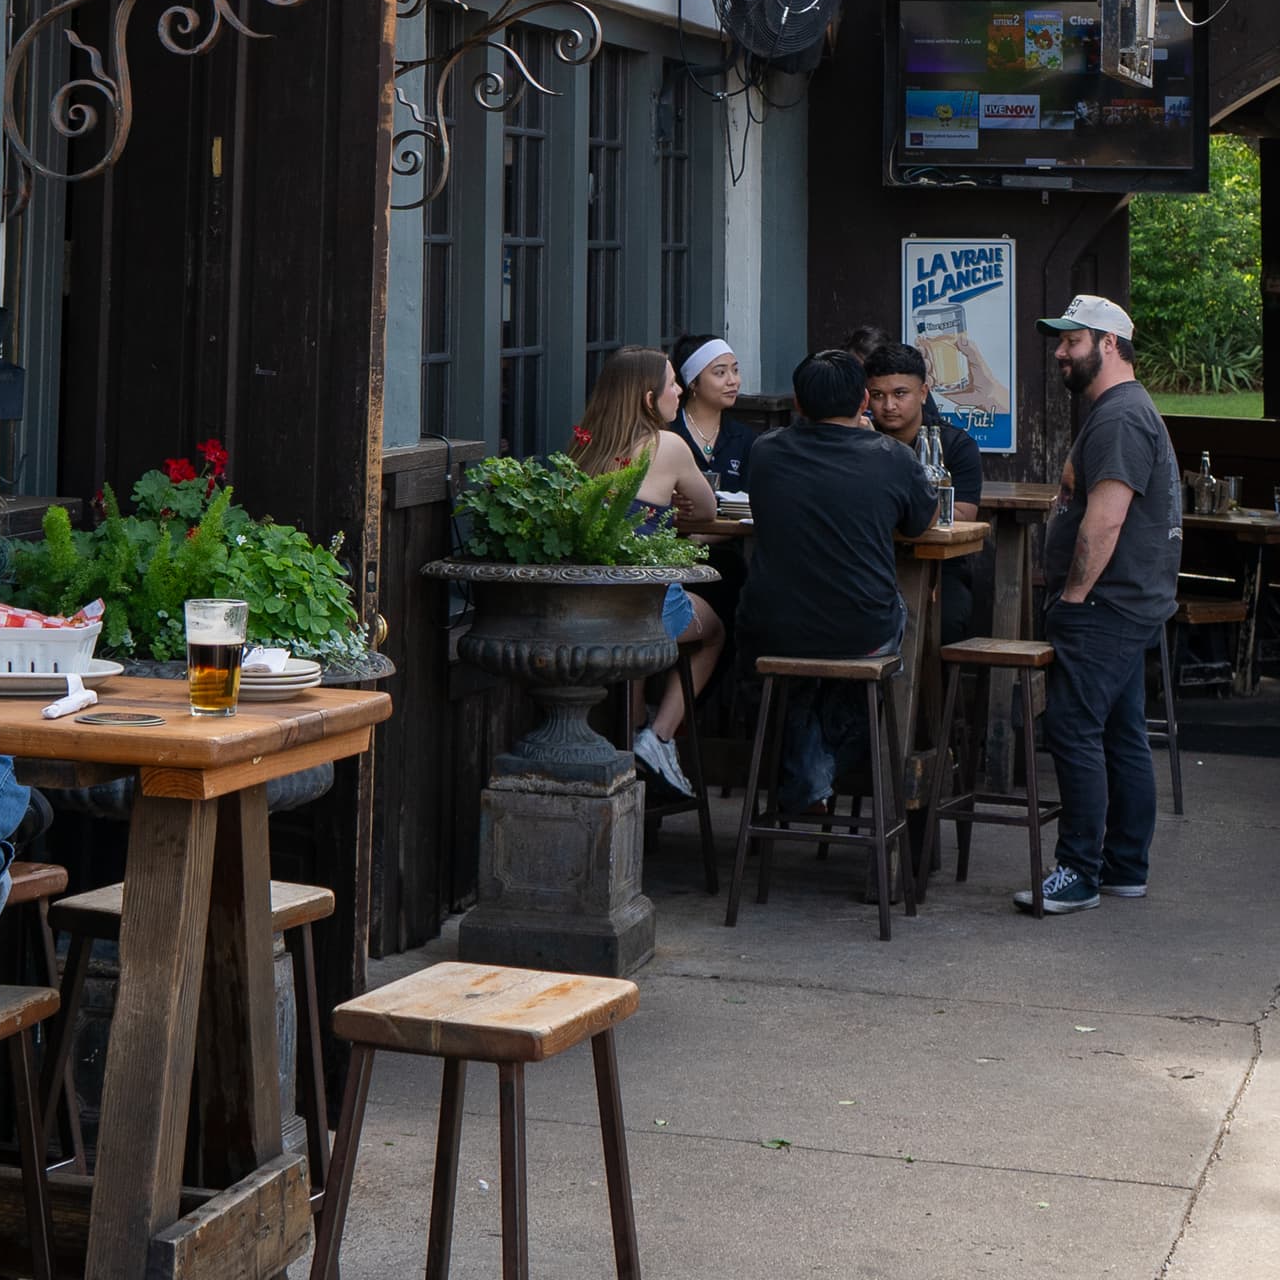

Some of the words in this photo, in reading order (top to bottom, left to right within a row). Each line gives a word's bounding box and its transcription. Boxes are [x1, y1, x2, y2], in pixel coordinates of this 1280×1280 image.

[916, 253, 948, 282] LA
[950, 247, 1003, 270] VRAIE
[912, 263, 1003, 311] BLANCHE
